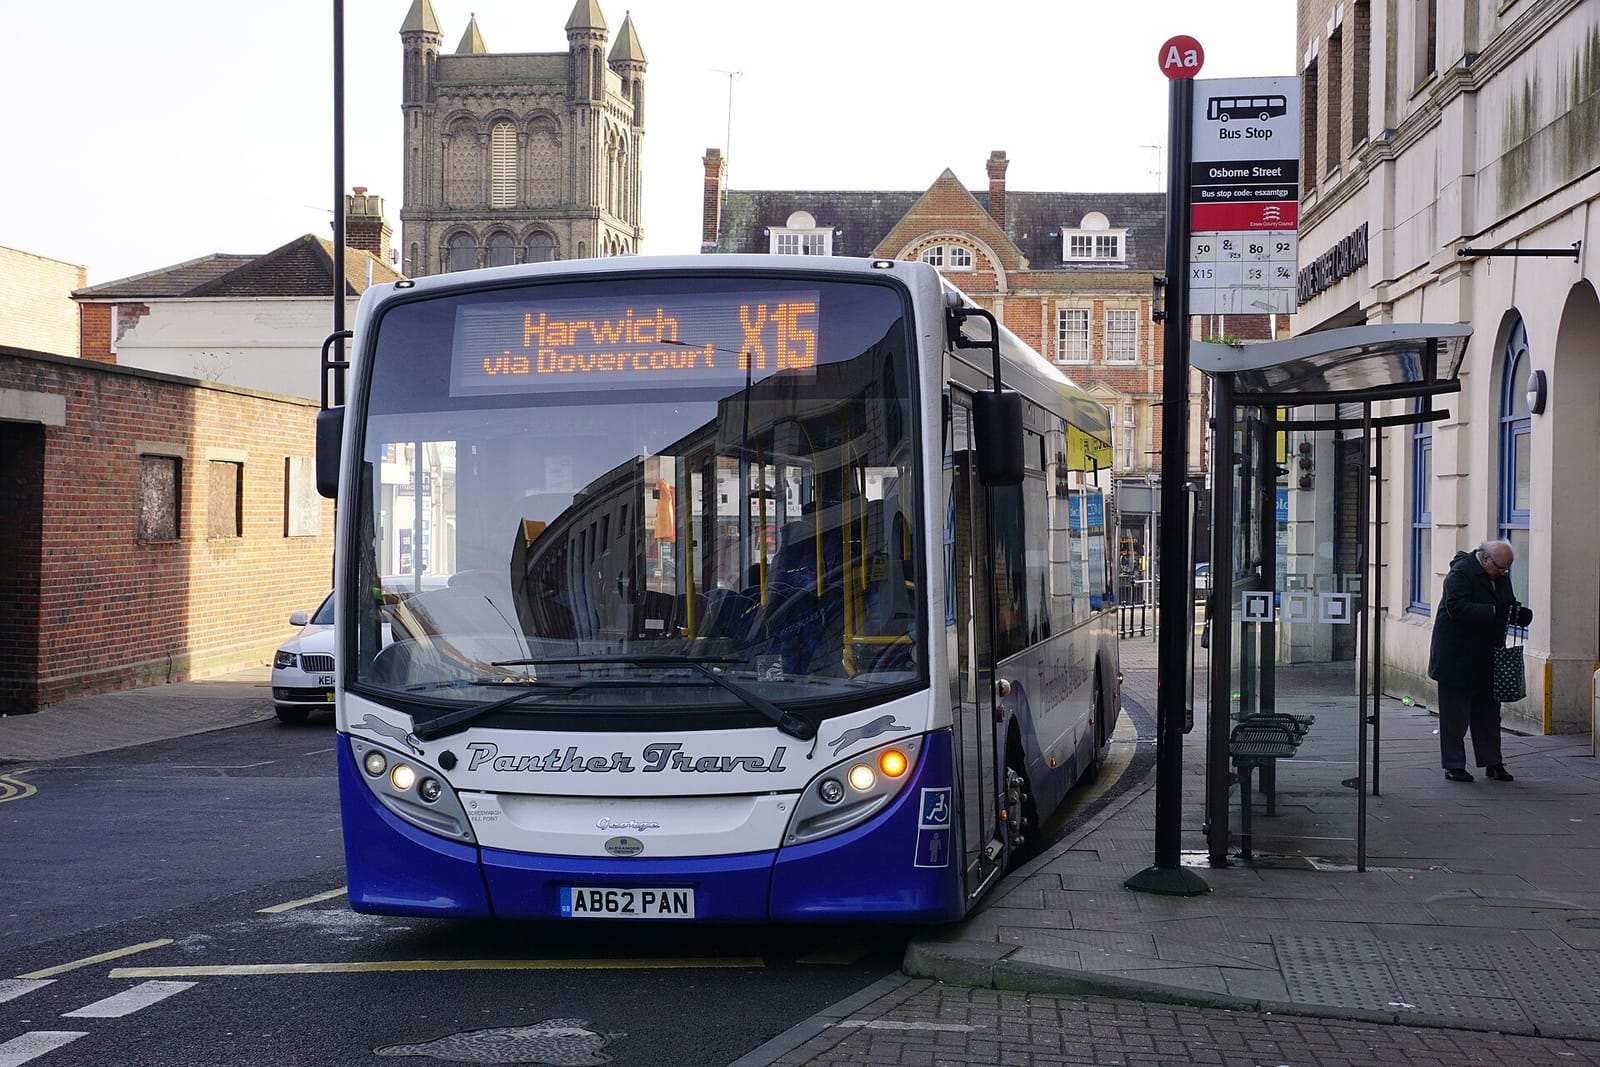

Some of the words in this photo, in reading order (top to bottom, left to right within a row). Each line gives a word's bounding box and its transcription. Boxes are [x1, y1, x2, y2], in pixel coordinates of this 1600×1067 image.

[1164, 45, 1198, 69] Aa
[1219, 128, 1242, 140] Bus
[1245, 126, 1273, 141] Stop
[1209, 167, 1250, 178] Osborne
[1252, 166, 1282, 177] Street
[1201, 190, 1215, 198] Bus
[1216, 189, 1232, 199] stop
[1233, 188, 1253, 197] code:
[1197, 244, 1211, 255] 50
[1249, 243, 1264, 254] 80
[1276, 242, 1290, 253] 92
[1192, 268, 1213, 279] X15
[1276, 266, 1291, 280] 94
[523, 307, 679, 348] Harwich
[738, 302, 816, 371] X15
[482, 349, 530, 376] via
[536, 342, 716, 375] Dovercourt
[318, 675, 336, 686] KE1
[466, 741, 636, 773] Panther
[641, 741, 788, 773] Travel
[574, 890, 635, 913] AB62
[641, 891, 688, 914] PAN
